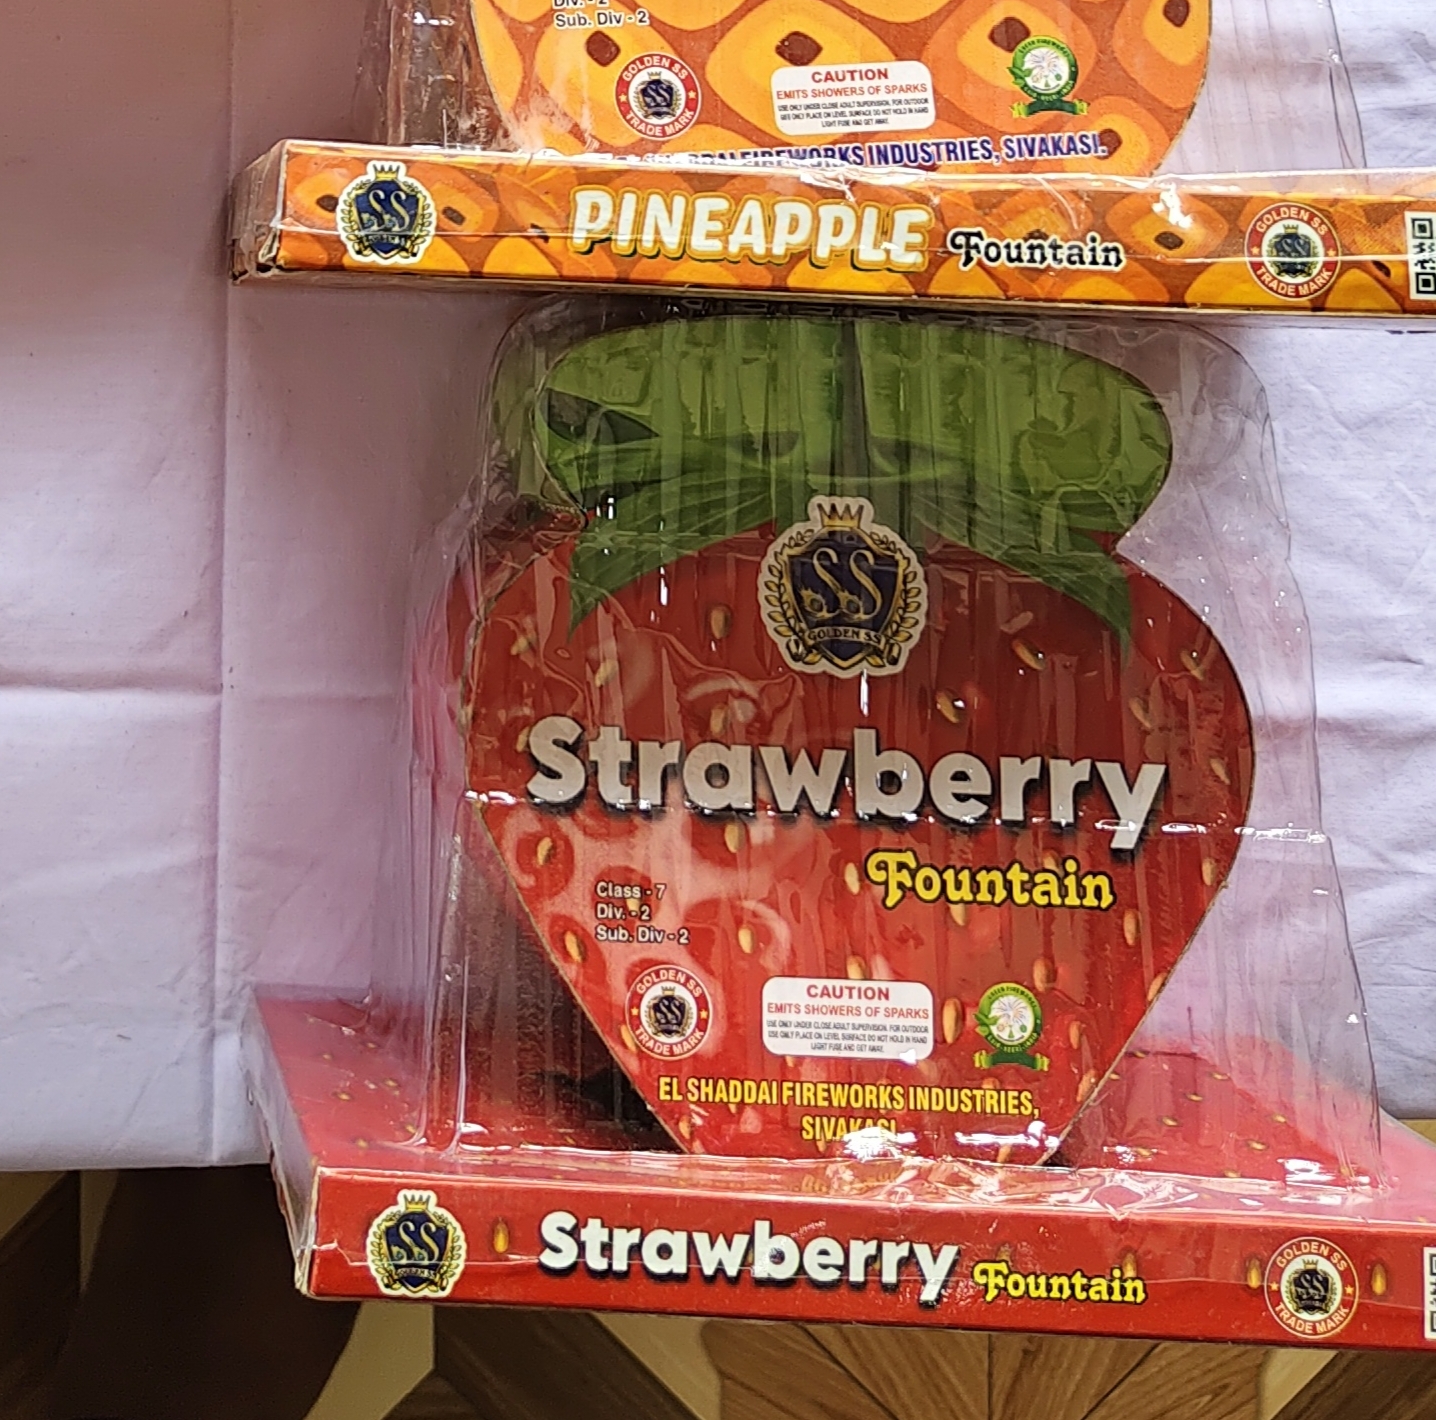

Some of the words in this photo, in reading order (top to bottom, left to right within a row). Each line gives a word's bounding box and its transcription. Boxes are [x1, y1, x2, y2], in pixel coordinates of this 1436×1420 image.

[555, 13, 591, 27] Sub.
[597, 12, 622, 25] Div
[622, 55, 670, 81] GOLDEN
[811, 68, 889, 83] CAUTION
[776, 88, 808, 100] EMITS
[811, 86, 864, 98] SHOWERS
[867, 85, 881, 95] OF
[885, 83, 927, 94] SPARKS
[625, 112, 663, 136] TRADE
[665, 110, 694, 135] MARK
[868, 139, 1000, 166] INDUSTRIES,
[1004, 134, 1106, 159] SIVAKASI.
[570, 187, 934, 272] PINEAPPLE
[949, 228, 1125, 270] Fountain
[1255, 207, 1309, 233] GOLDEN
[1256, 267, 1296, 296] TRADE
[1297, 268, 1332, 295] MARK
[525, 715, 1166, 854] Strawberry
[596, 881, 641, 898] Class
[865, 848, 1115, 910] Fountain
[596, 903, 626, 919] Div.
[596, 925, 633, 941] Sub.
[637, 927, 664, 943] Div
[636, 969, 686, 995] GOLDEN
[806, 984, 890, 1001] CAUTION
[767, 1002, 801, 1014] EMITS
[804, 1004, 861, 1017] SHOWERS
[865, 1006, 880, 1017] OF
[884, 1007, 929, 1020] SPARKS
[634, 1028, 671, 1055] TRADE
[672, 1030, 704, 1054] MARK
[659, 1076, 683, 1102] EL
[686, 1077, 778, 1105] SHADDAI
[781, 1083, 905, 1111] FIREWORKS
[907, 1085, 1040, 1119] INDUSTRIES,
[536, 1210, 960, 1308] Strawberry
[972, 1261, 1146, 1304] Fountain
[1275, 1241, 1330, 1269] GOLDEN
[1275, 1302, 1313, 1334] TRADE
[1315, 1304, 1350, 1334] MARK
